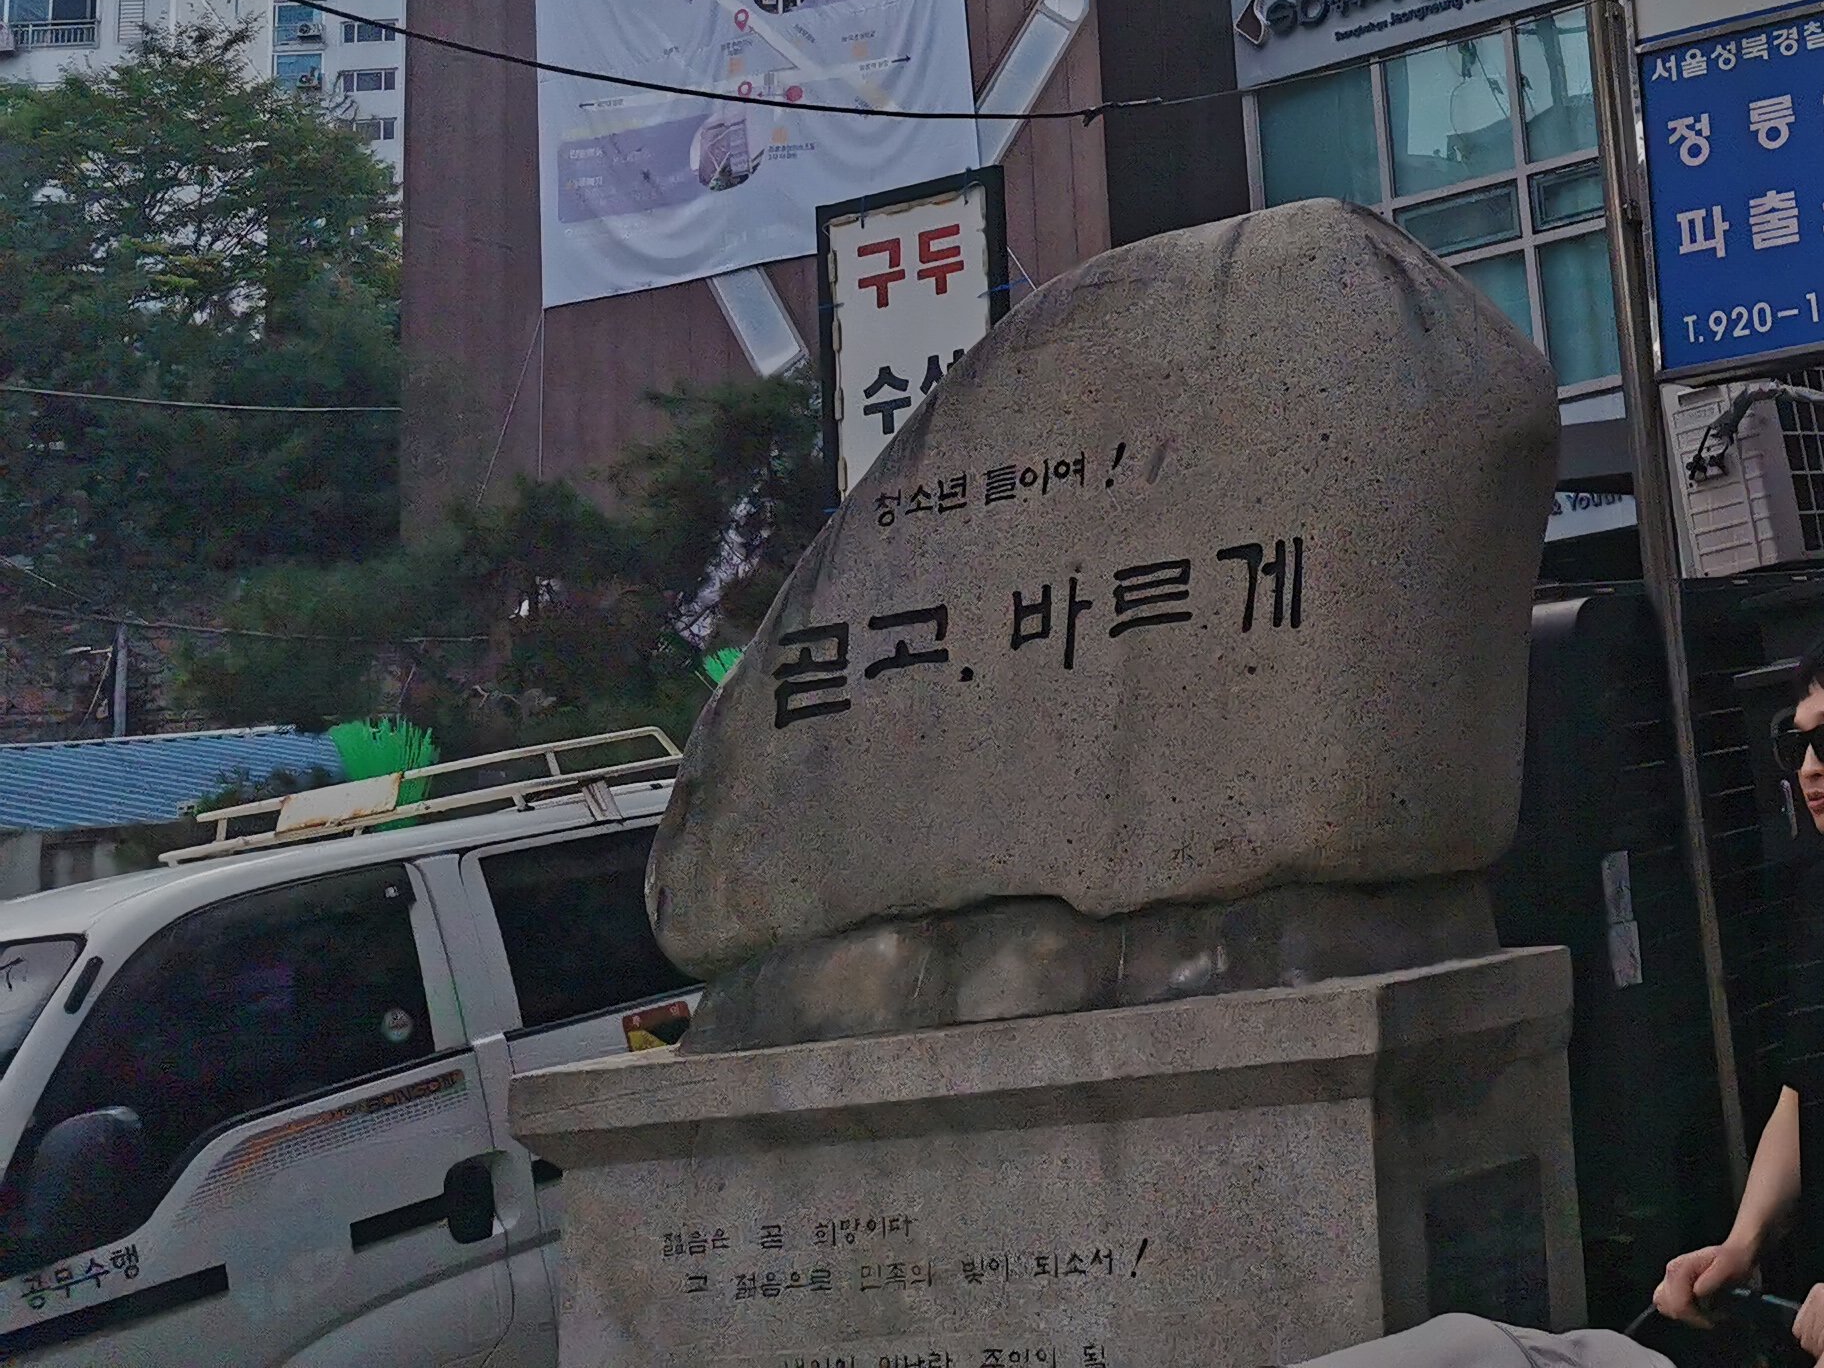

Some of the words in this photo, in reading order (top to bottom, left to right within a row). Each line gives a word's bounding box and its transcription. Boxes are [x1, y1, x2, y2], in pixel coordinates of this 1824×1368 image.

[856, 222, 965, 309] 구두
[873, 472, 968, 527] 청소년
[1011, 536, 1306, 671] 바르게
[815, 1214, 914, 1247] 희망이다
[20, 1243, 141, 1310] 공무수행
